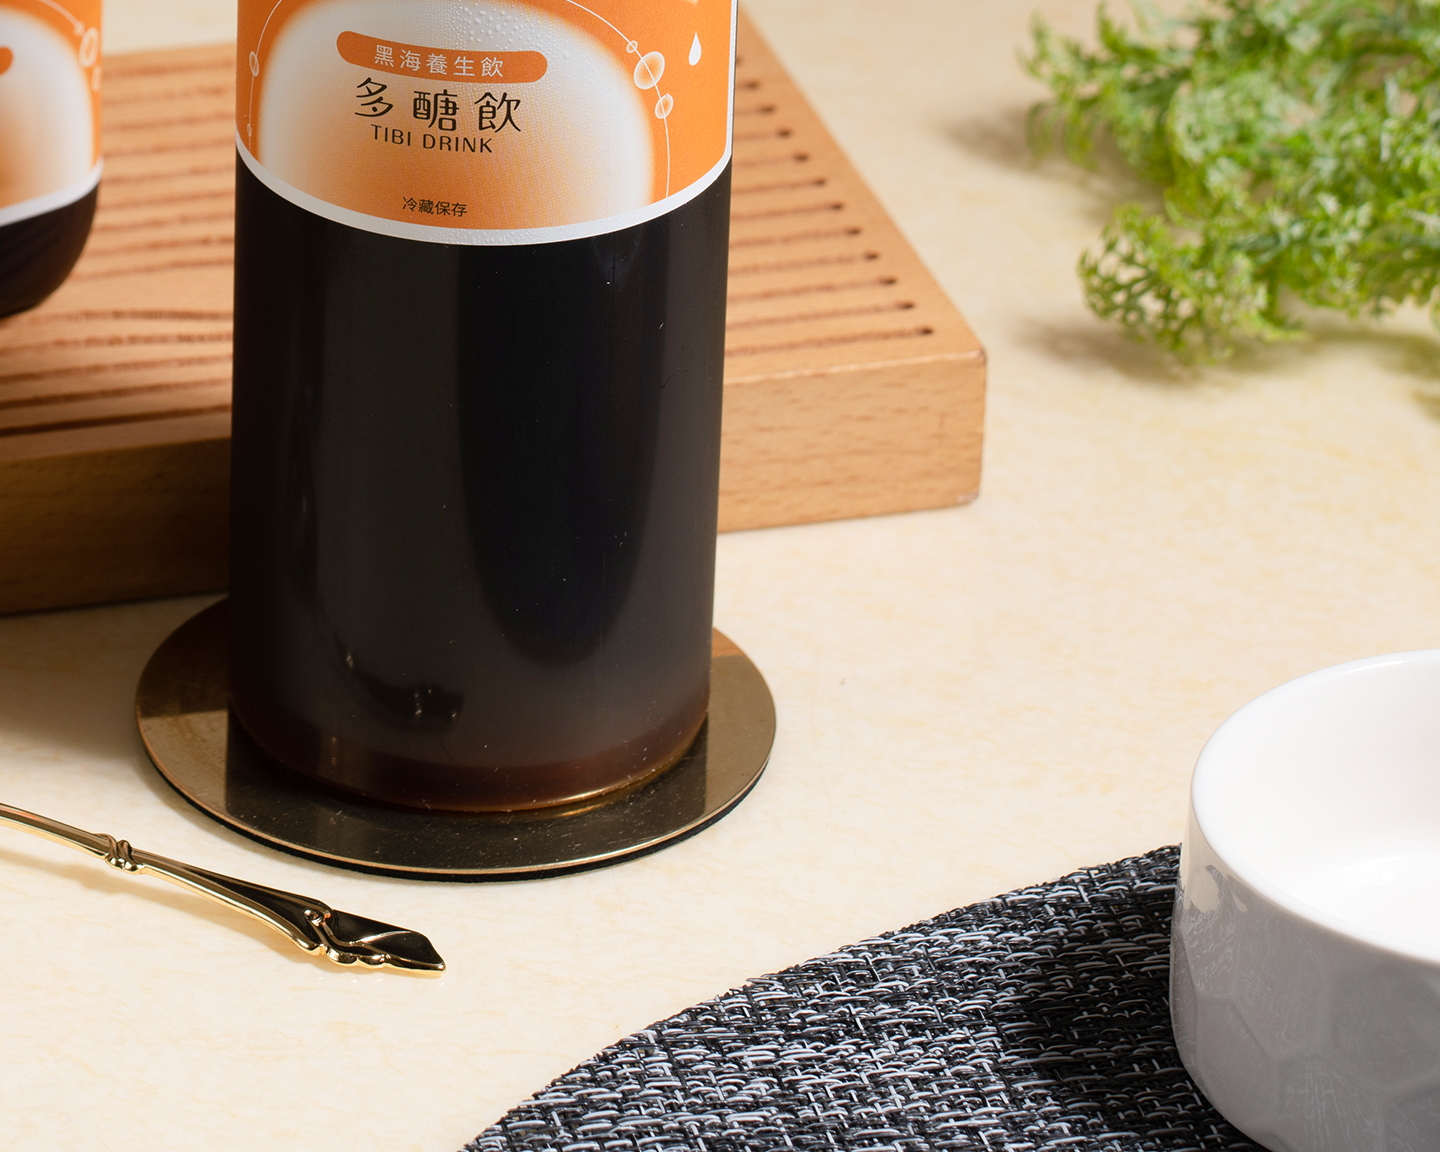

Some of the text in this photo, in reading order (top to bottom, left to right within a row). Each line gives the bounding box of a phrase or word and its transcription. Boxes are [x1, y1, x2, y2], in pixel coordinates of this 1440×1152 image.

[374, 44, 504, 78] 黑海養生飲
[354, 77, 522, 133] 多醣飲
[370, 123, 493, 154] TIBI DRINK
[402, 196, 468, 218] 冷藏保存
